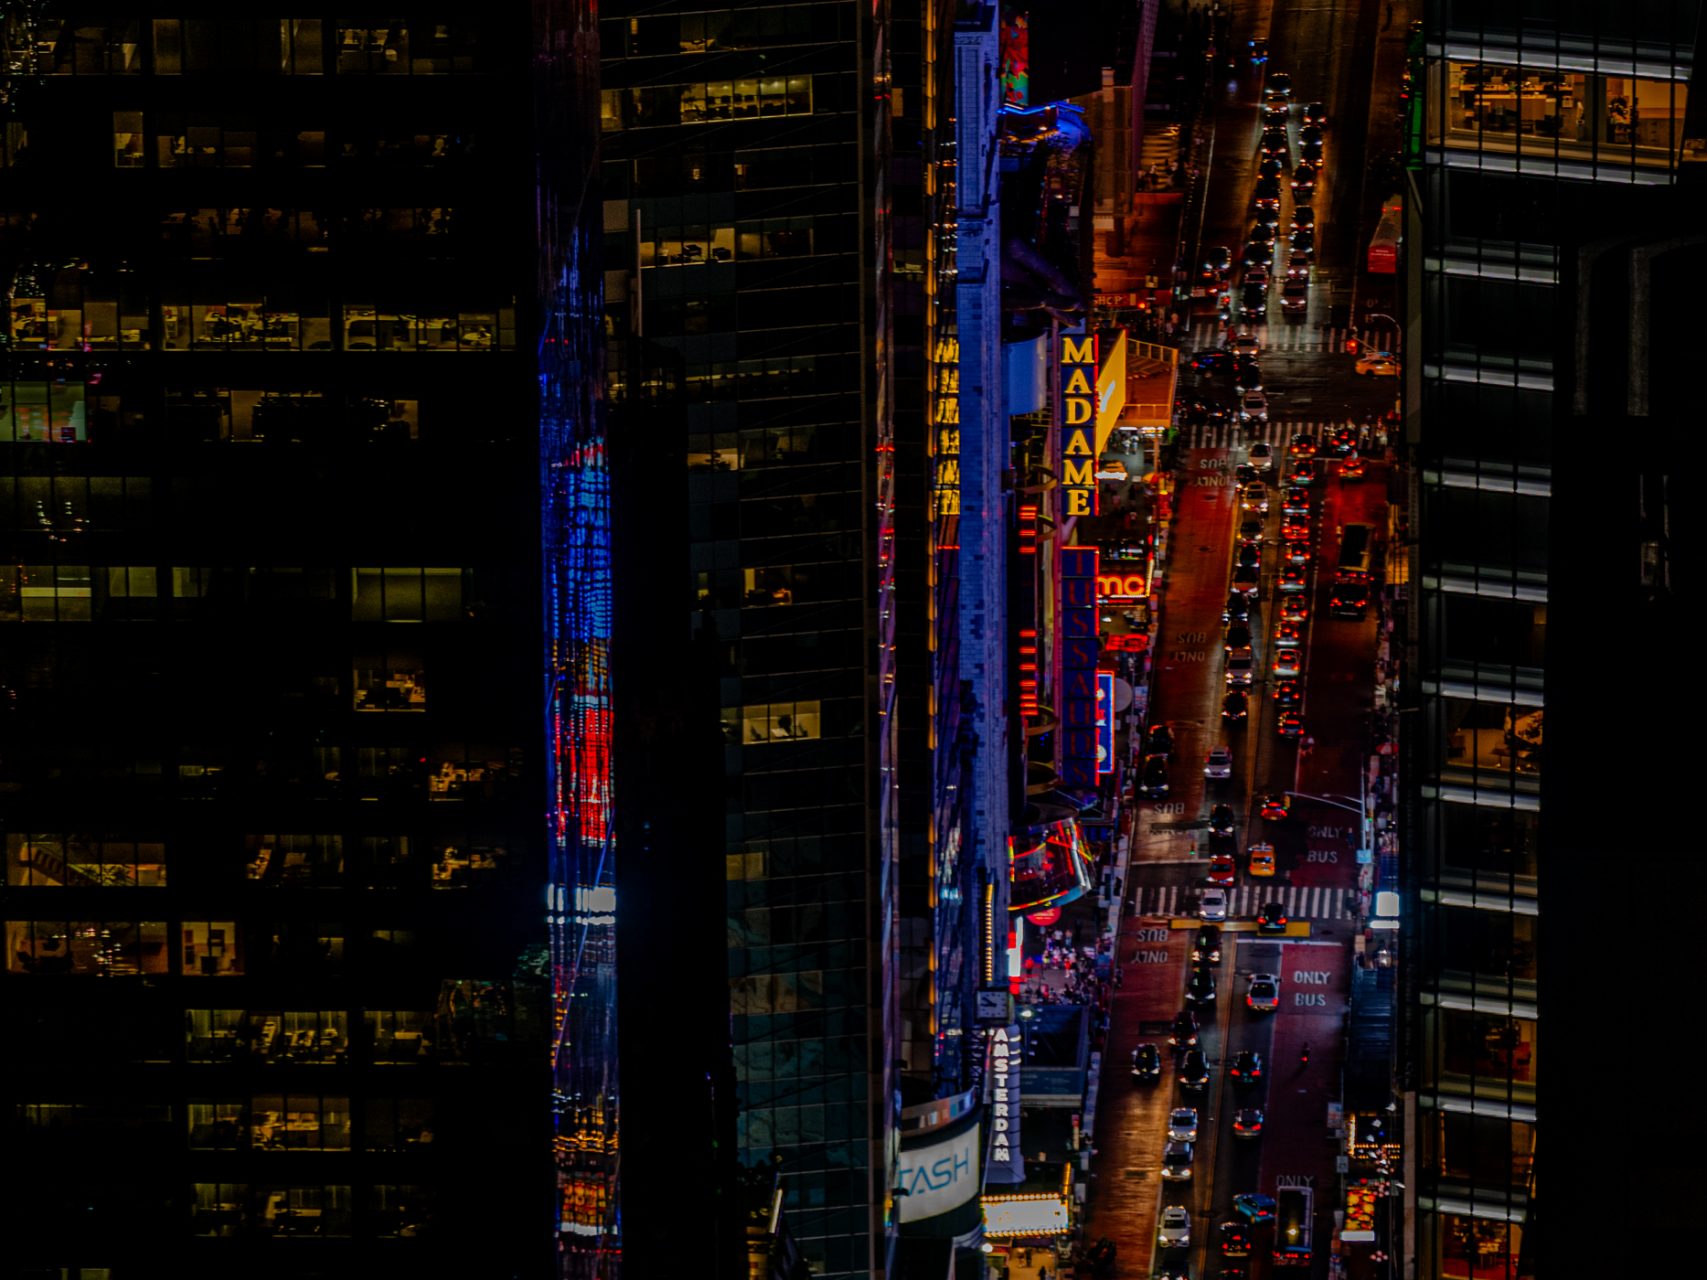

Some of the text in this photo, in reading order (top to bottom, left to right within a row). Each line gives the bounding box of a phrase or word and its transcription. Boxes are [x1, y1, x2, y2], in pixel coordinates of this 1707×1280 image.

[1061, 337, 1095, 516] MADAME
[1178, 631, 1207, 644] BUS
[1171, 651, 1206, 664] ONLY
[1067, 550, 1092, 785] TUSSAUDS
[1306, 849, 1338, 864] BUS
[1137, 929, 1169, 943] BUS
[1131, 950, 1169, 965] ONLY
[1294, 970, 1331, 985] ONLY
[1295, 992, 1326, 1007] BUS
[993, 1027, 1010, 1162] AMSTERDAM
